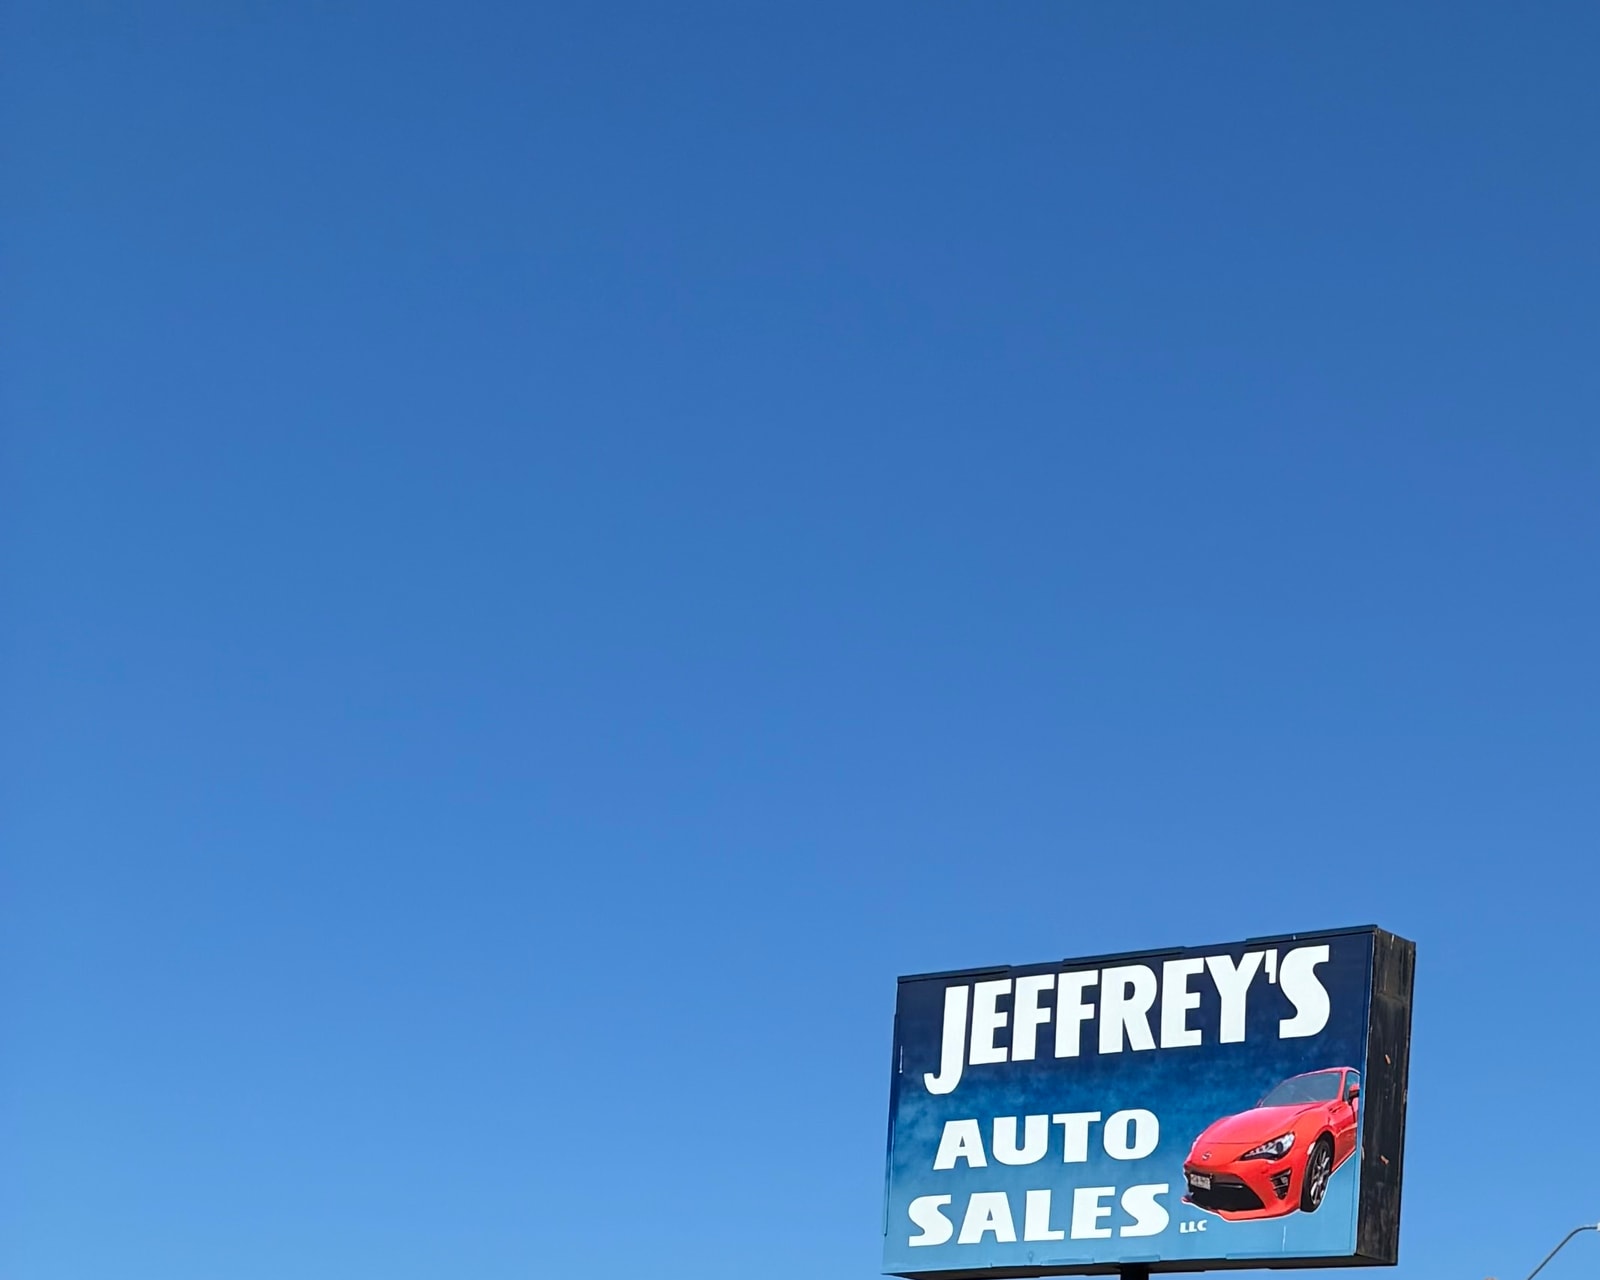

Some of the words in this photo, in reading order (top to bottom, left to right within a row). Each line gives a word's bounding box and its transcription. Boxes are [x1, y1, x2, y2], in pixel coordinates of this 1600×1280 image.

[923, 944, 1330, 1095] JEFFREY'S
[933, 1108, 1161, 1171] AUTO
[907, 1183, 1170, 1248] SALES
[1180, 1219, 1208, 1234] LLC
